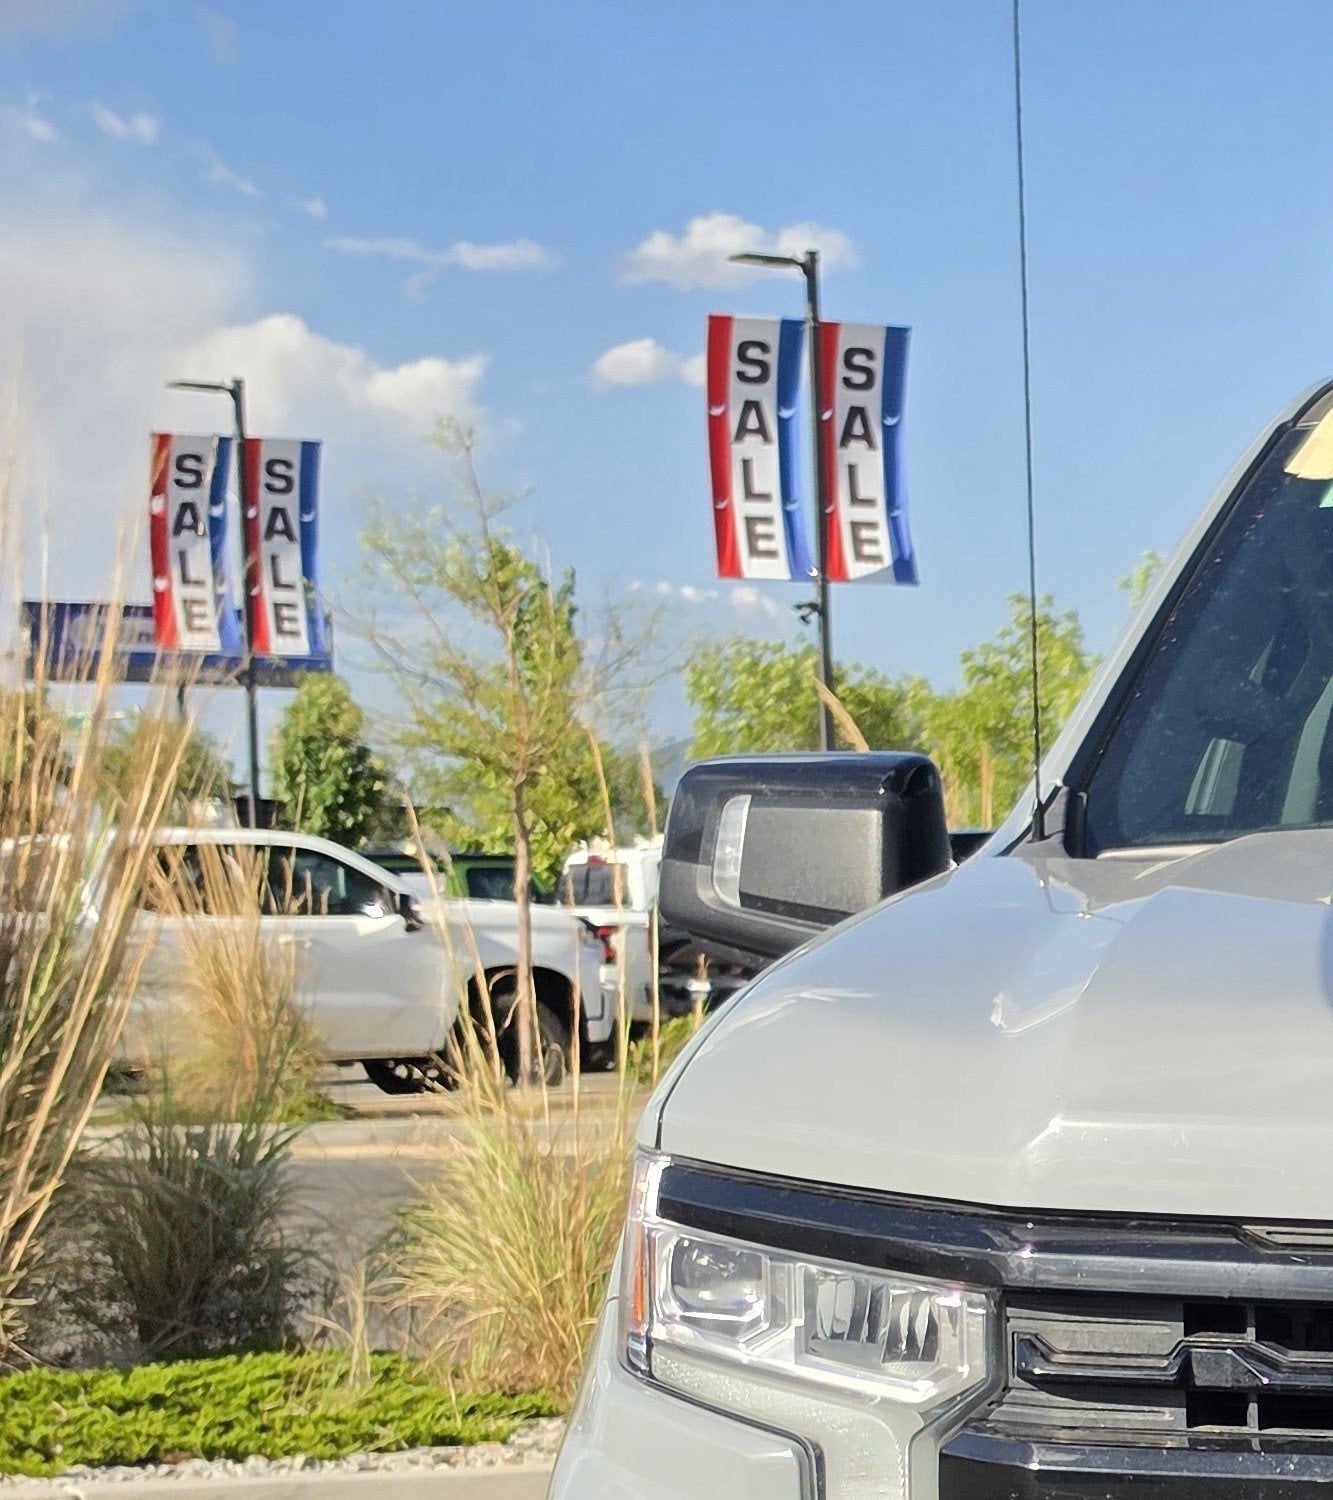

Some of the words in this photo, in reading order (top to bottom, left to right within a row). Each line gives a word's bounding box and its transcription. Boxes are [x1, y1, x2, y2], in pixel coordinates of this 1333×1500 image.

[173, 453, 211, 634] SALE
[264, 458, 303, 637] SALE
[732, 339, 780, 561] SALE
[838, 346, 885, 564] SALE
